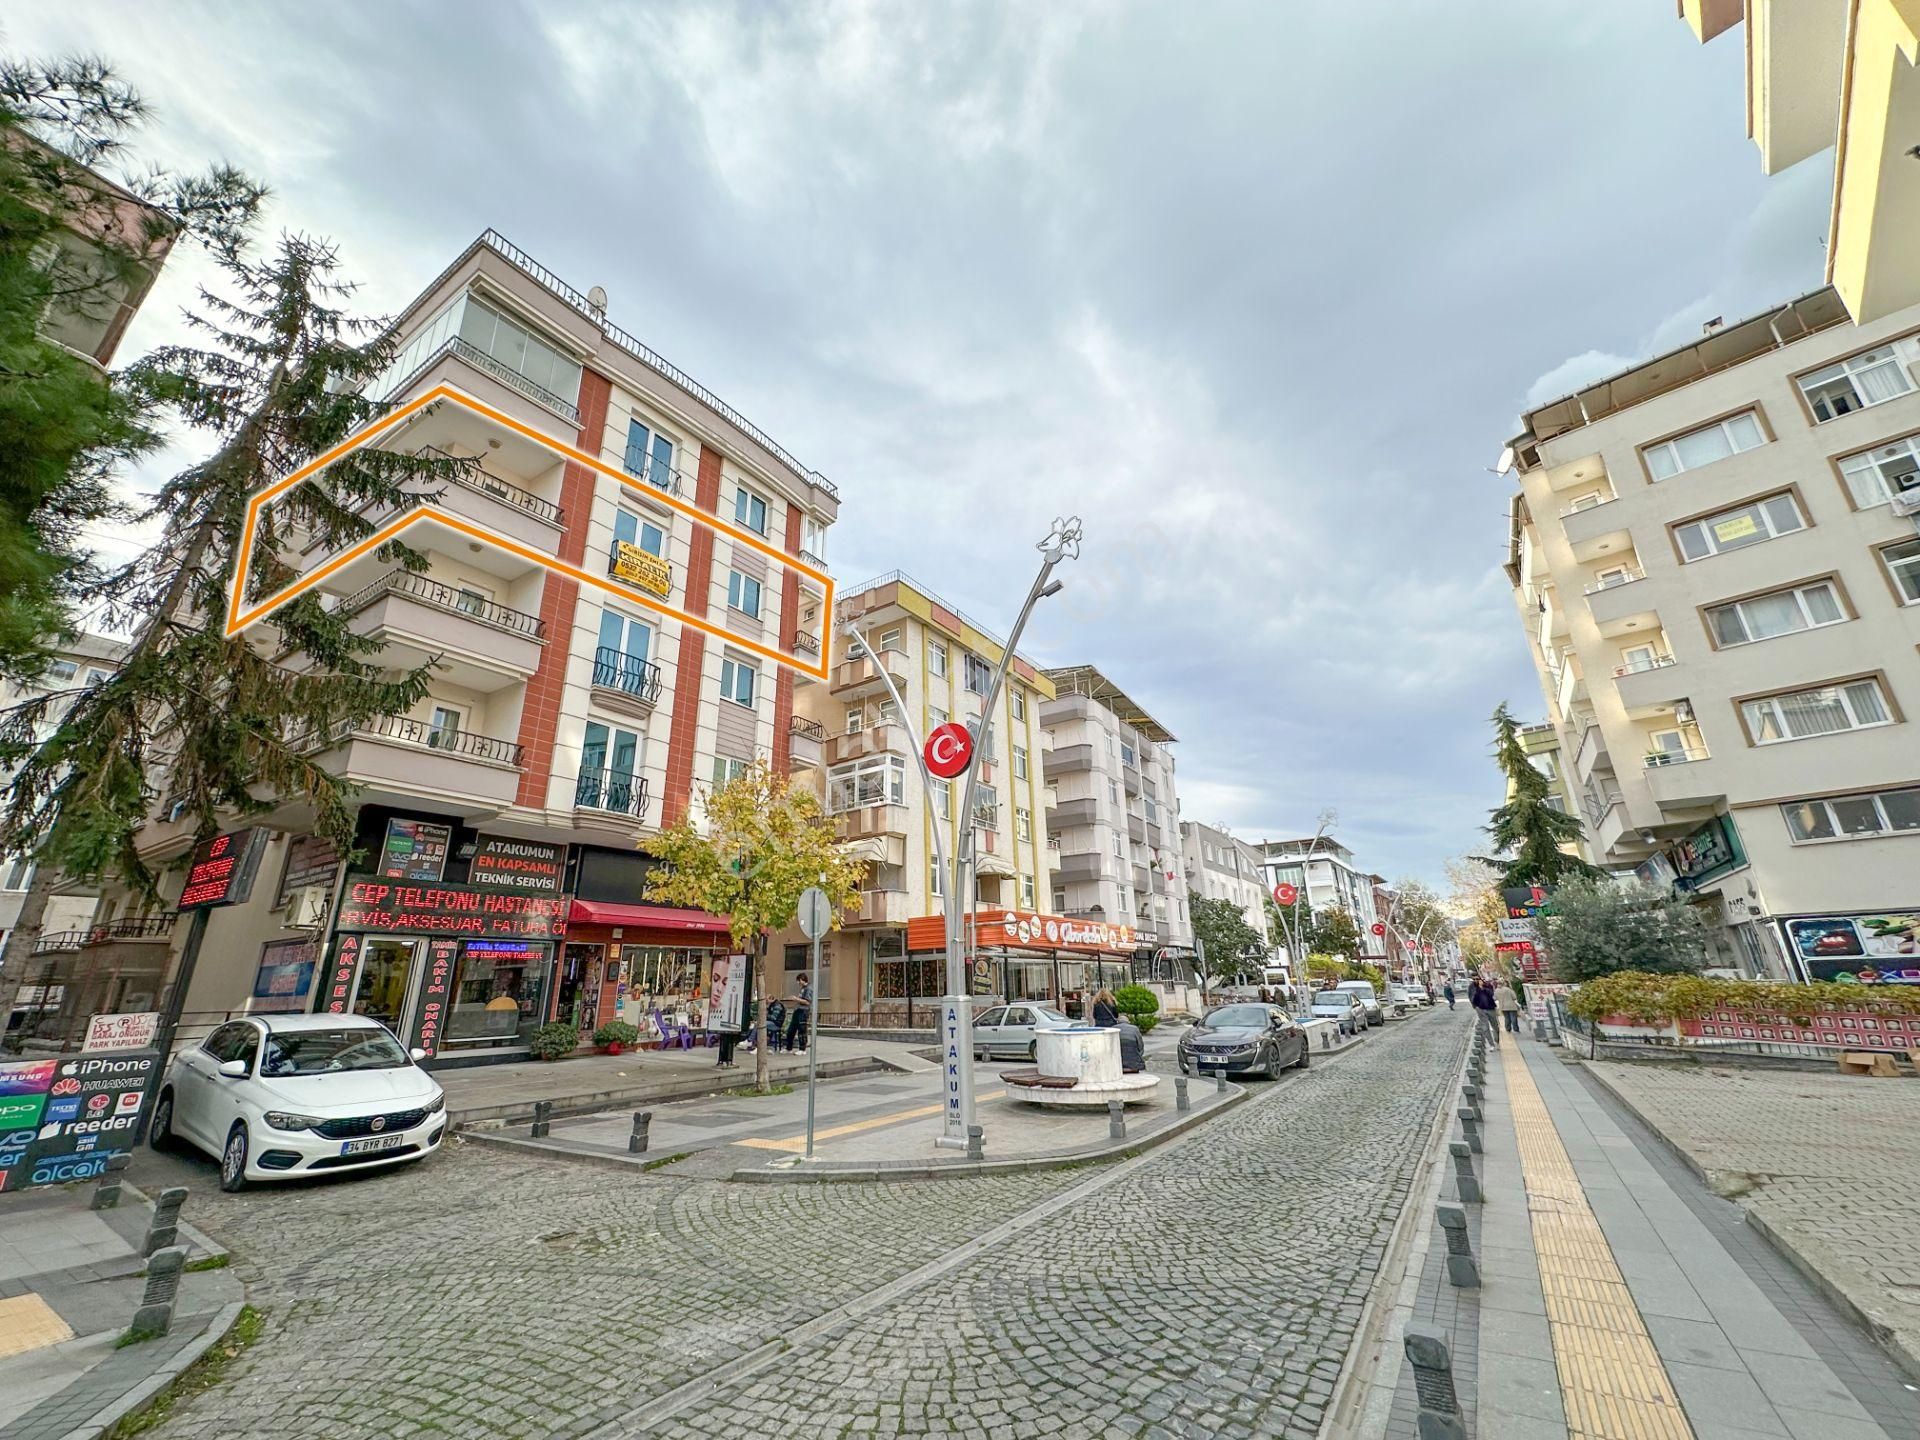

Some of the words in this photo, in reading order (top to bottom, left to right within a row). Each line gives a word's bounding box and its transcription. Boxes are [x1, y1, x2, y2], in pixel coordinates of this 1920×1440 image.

[486, 841, 555, 860] ATAKUMUN
[478, 855, 495, 868] EN
[497, 858, 557, 875] KAPSAMLI
[475, 871, 515, 886] TEKNİK
[515, 876, 556, 890] SERVİSİ
[351, 882, 390, 904] CEP
[394, 886, 481, 911] TELEFONU
[483, 894, 567, 916] HASTANESİ
[492, 919, 549, 935] FATURA
[427, 949, 450, 993] BAKIM
[88, 1041, 109, 1049] PARK
[111, 1038, 148, 1047] YAPILMAZ
[80, 1059, 151, 1075] iPhone
[948, 1008, 959, 1109] ATAKUM
[82, 1077, 145, 1092] HUAWEI
[64, 1116, 137, 1135] reeder
[348, 1143, 360, 1153] 34
[362, 1139, 380, 1151] BYR
[32, 1159, 106, 1184] alcat
